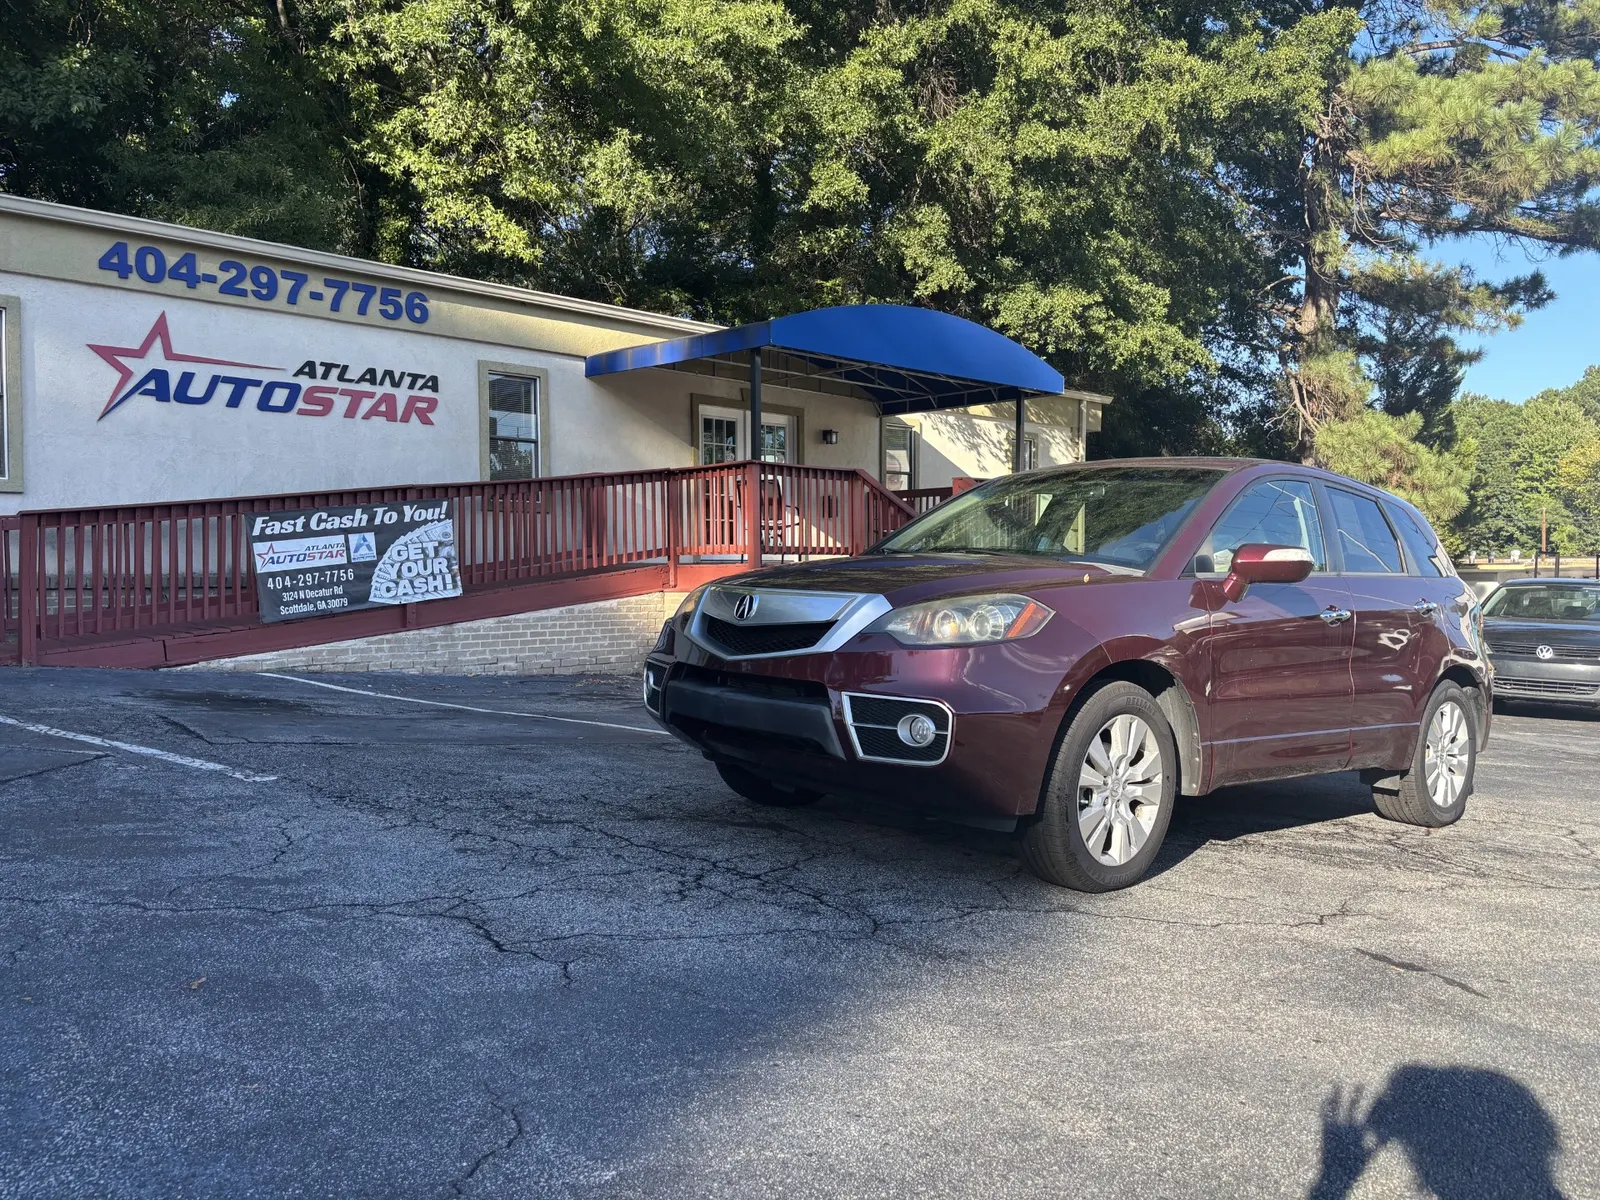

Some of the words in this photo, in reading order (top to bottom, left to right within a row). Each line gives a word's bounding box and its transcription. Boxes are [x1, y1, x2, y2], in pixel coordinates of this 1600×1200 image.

[98, 241, 429, 324] 404-297-7756
[292, 360, 440, 393] ATLANTA
[98, 368, 439, 426] AUTOSTAR
[252, 516, 307, 536] Fast
[310, 508, 368, 531] Cash
[373, 507, 398, 525] To
[403, 501, 448, 523] You!
[261, 549, 345, 566] AUTOSTAR
[304, 542, 346, 552] ATLANTA
[392, 541, 439, 562] GET
[267, 568, 354, 590] 404-297-7756
[384, 557, 449, 580] YOUR
[282, 592, 298, 601] 3124
[299, 591, 305, 600] N
[306, 588, 333, 598] Decatur
[334, 585, 343, 595] Rd
[379, 573, 453, 598] CASH!
[280, 602, 317, 615] Scottdale,
[317, 600, 327, 609] GA
[328, 598, 348, 608] 30079
